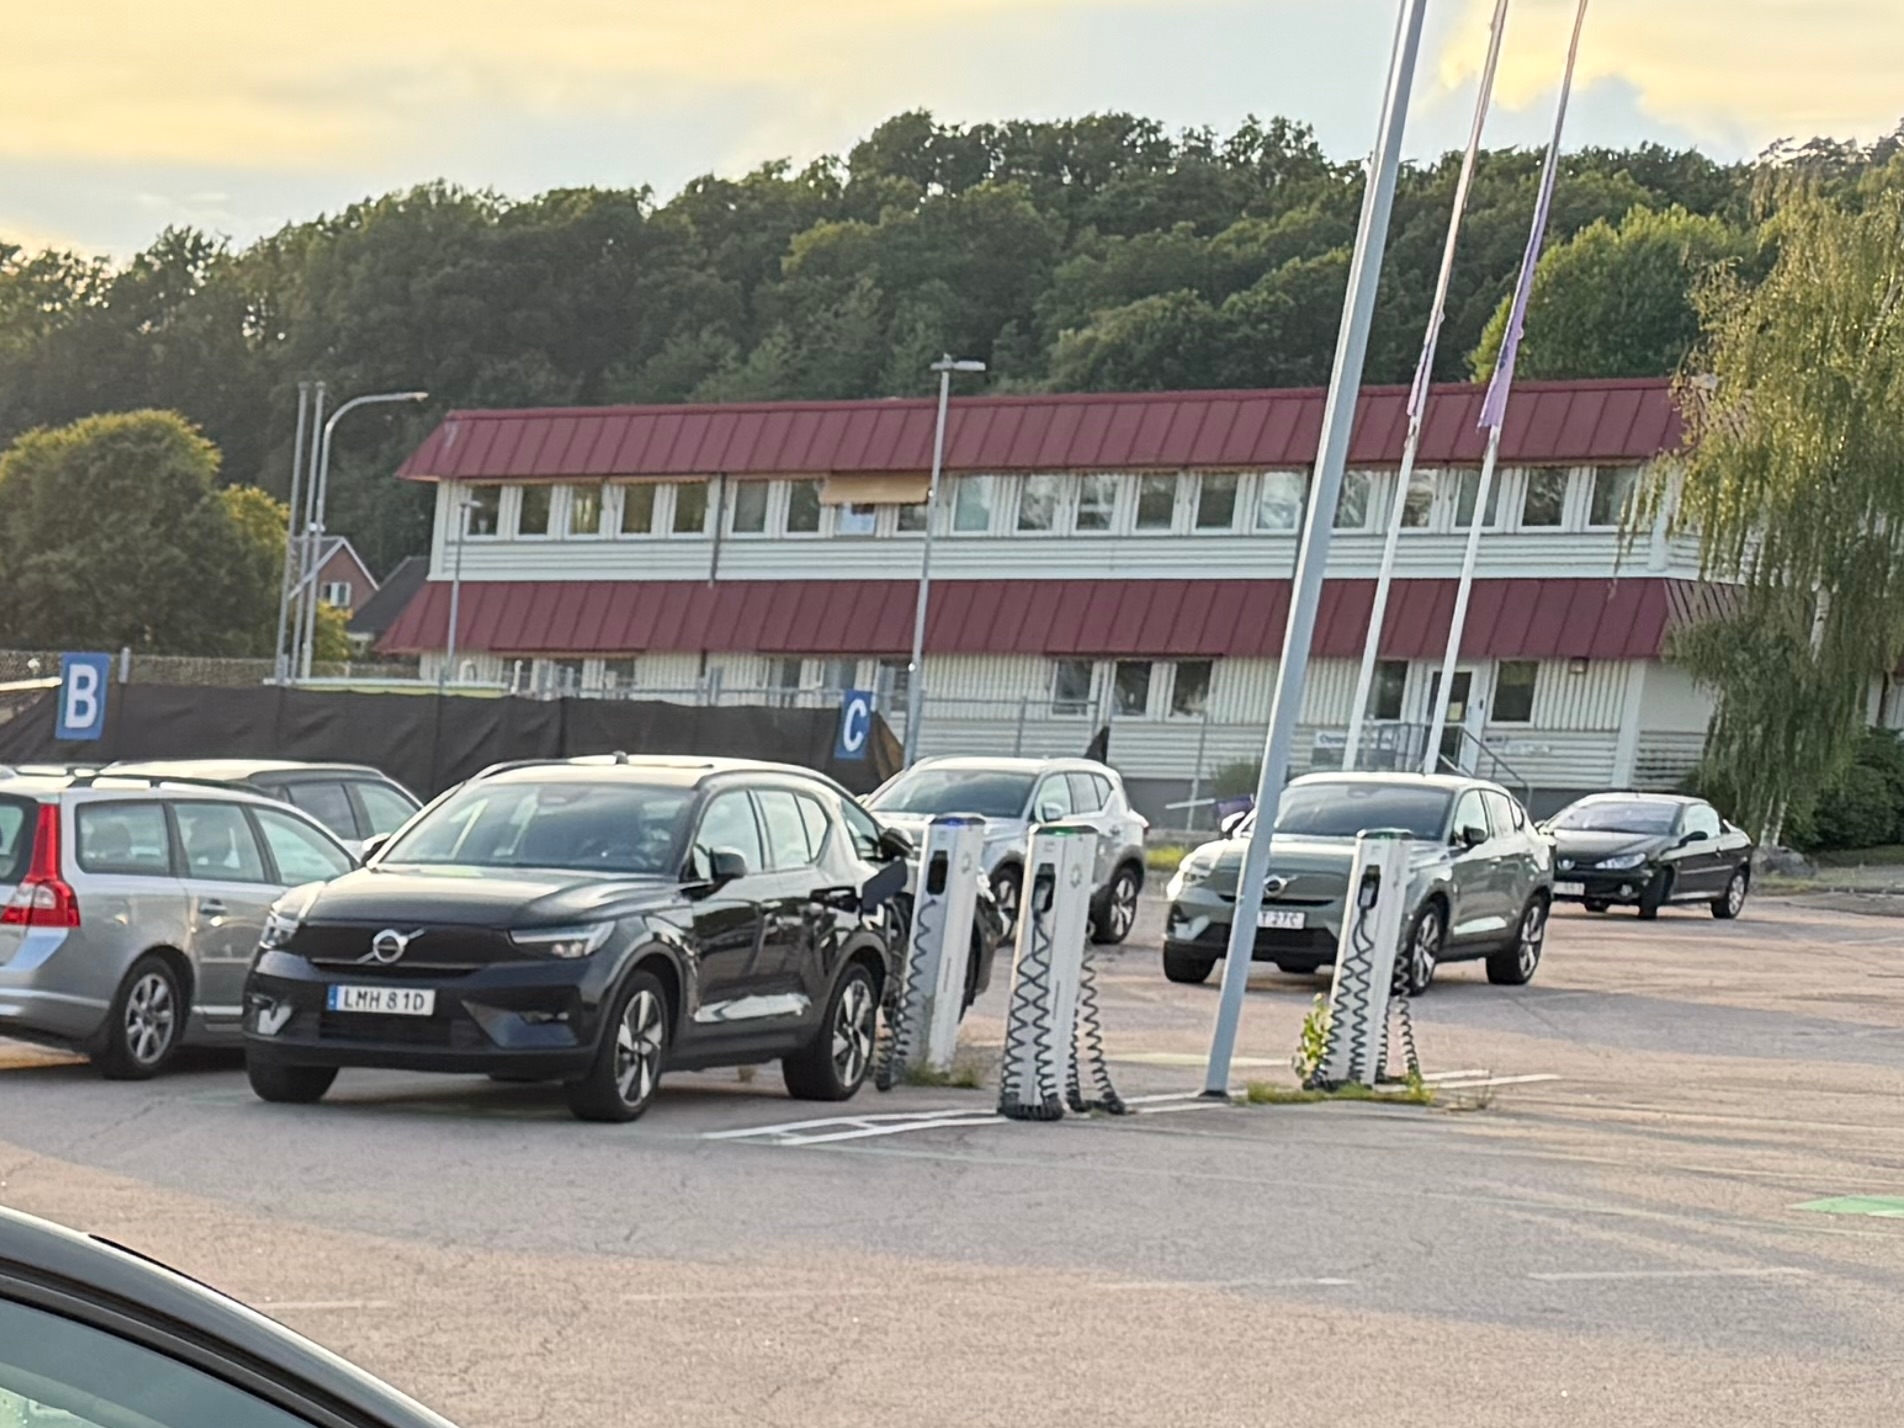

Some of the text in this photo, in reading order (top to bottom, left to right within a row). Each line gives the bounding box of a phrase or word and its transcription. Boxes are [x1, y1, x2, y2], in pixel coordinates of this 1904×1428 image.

[65, 664, 98, 728] B
[843, 698, 867, 751] C
[344, 988, 425, 1011] LMH 81D
